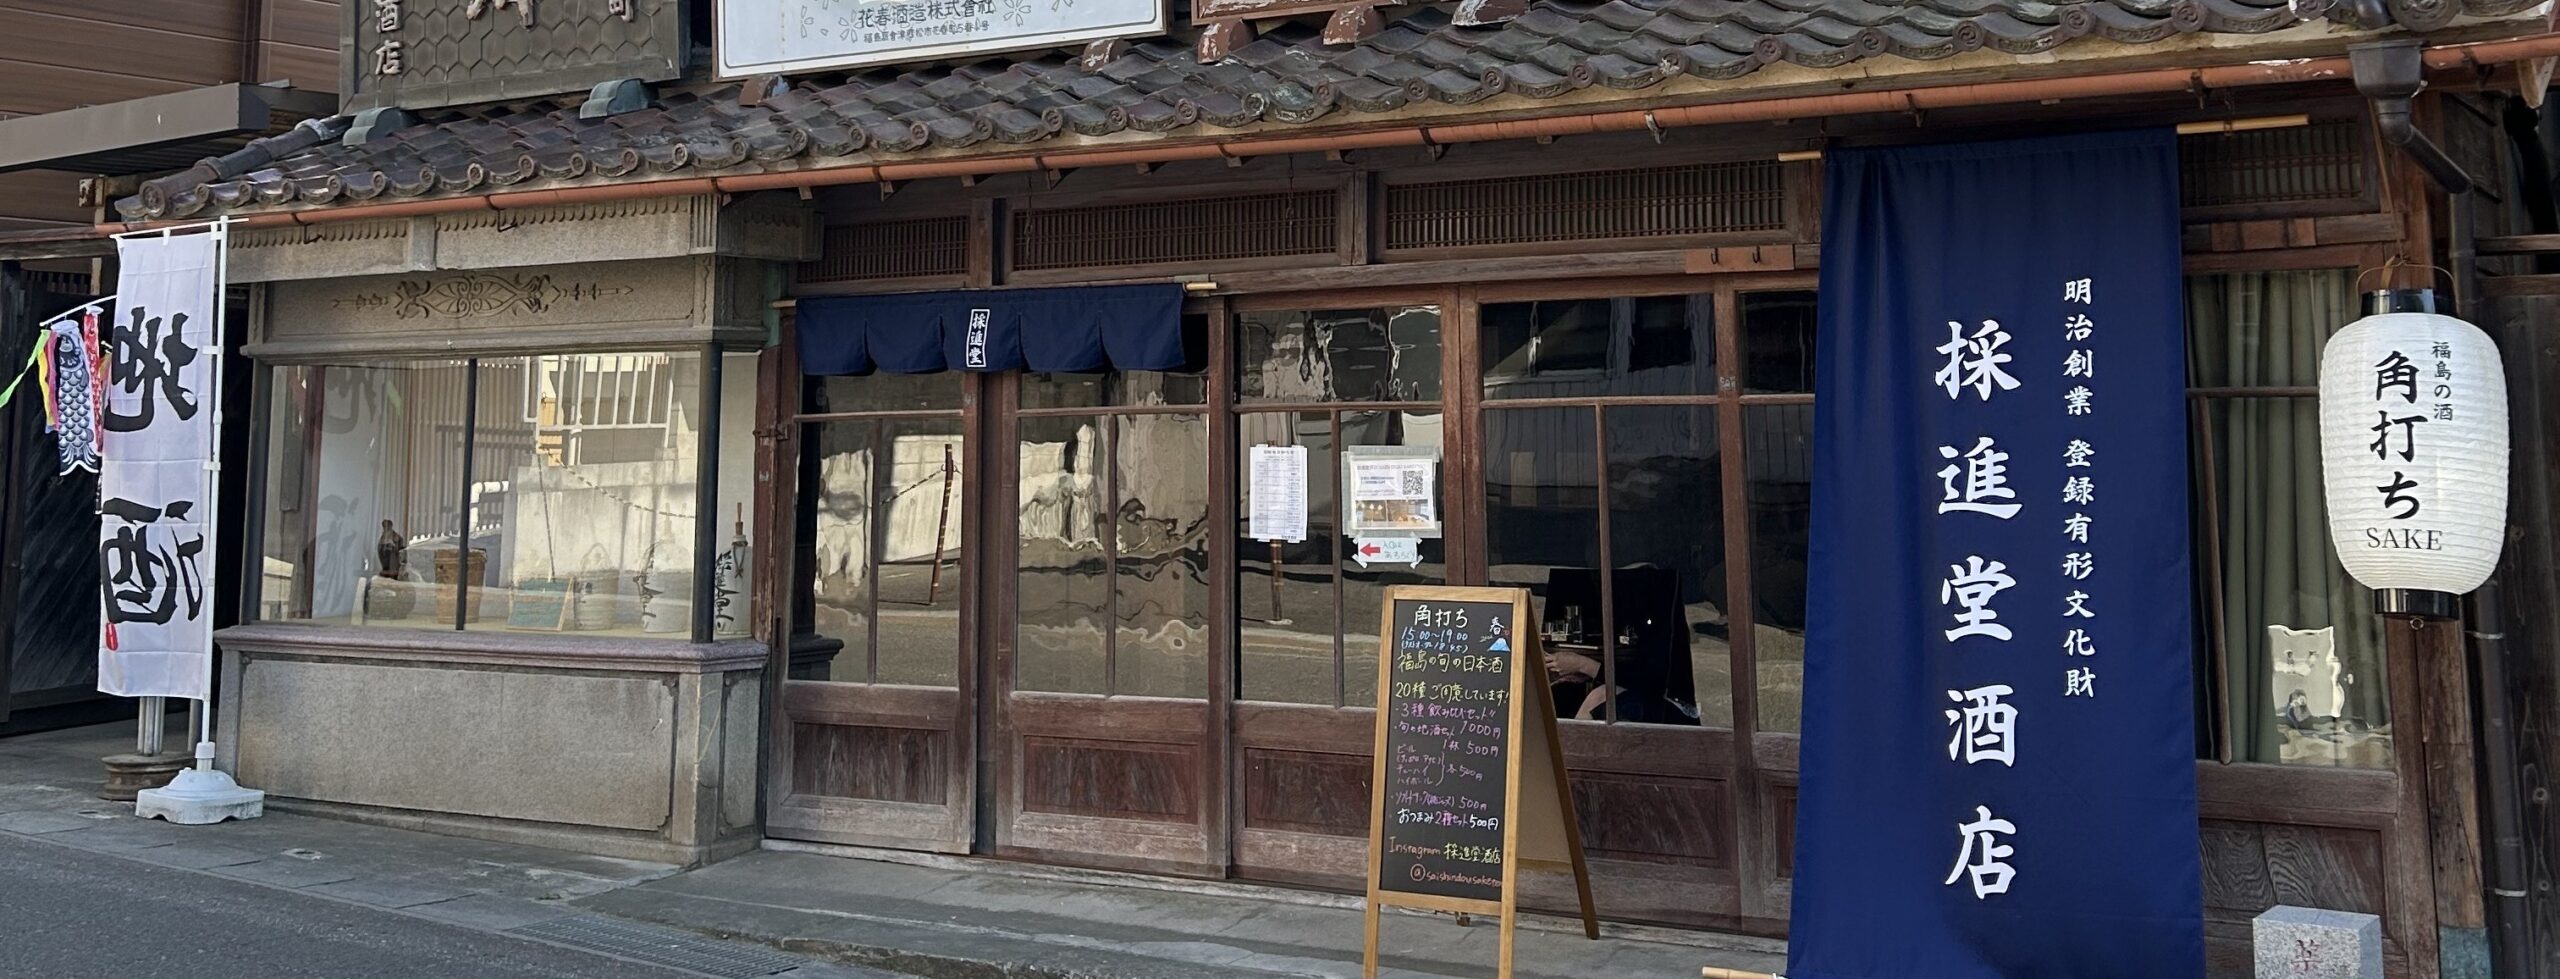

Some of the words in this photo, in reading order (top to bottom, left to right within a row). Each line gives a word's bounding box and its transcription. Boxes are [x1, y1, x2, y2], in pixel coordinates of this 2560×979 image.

[969, 313, 986, 364] 採進堂
[2063, 277, 2094, 416] 明治創業
[2432, 341, 2454, 421] 福島の酒
[2369, 350, 2428, 520] 角打ち
[2365, 527, 2443, 551] SAKE
[2062, 438, 2096, 699] 登録有形文化財
[1414, 604, 1468, 628] 角打ち
[1934, 318, 2022, 901] 採進堂酒店
[1489, 615, 1505, 635] 春
[1397, 650, 1503, 673] 福島の旬の日本酒
[1460, 720, 1501, 739] 1000円
[1466, 741, 1499, 757] 500円
[1459, 796, 1487, 811] 500円
[1389, 836, 1440, 859] Instagram
[1443, 843, 1501, 864] 採進堂酒店
